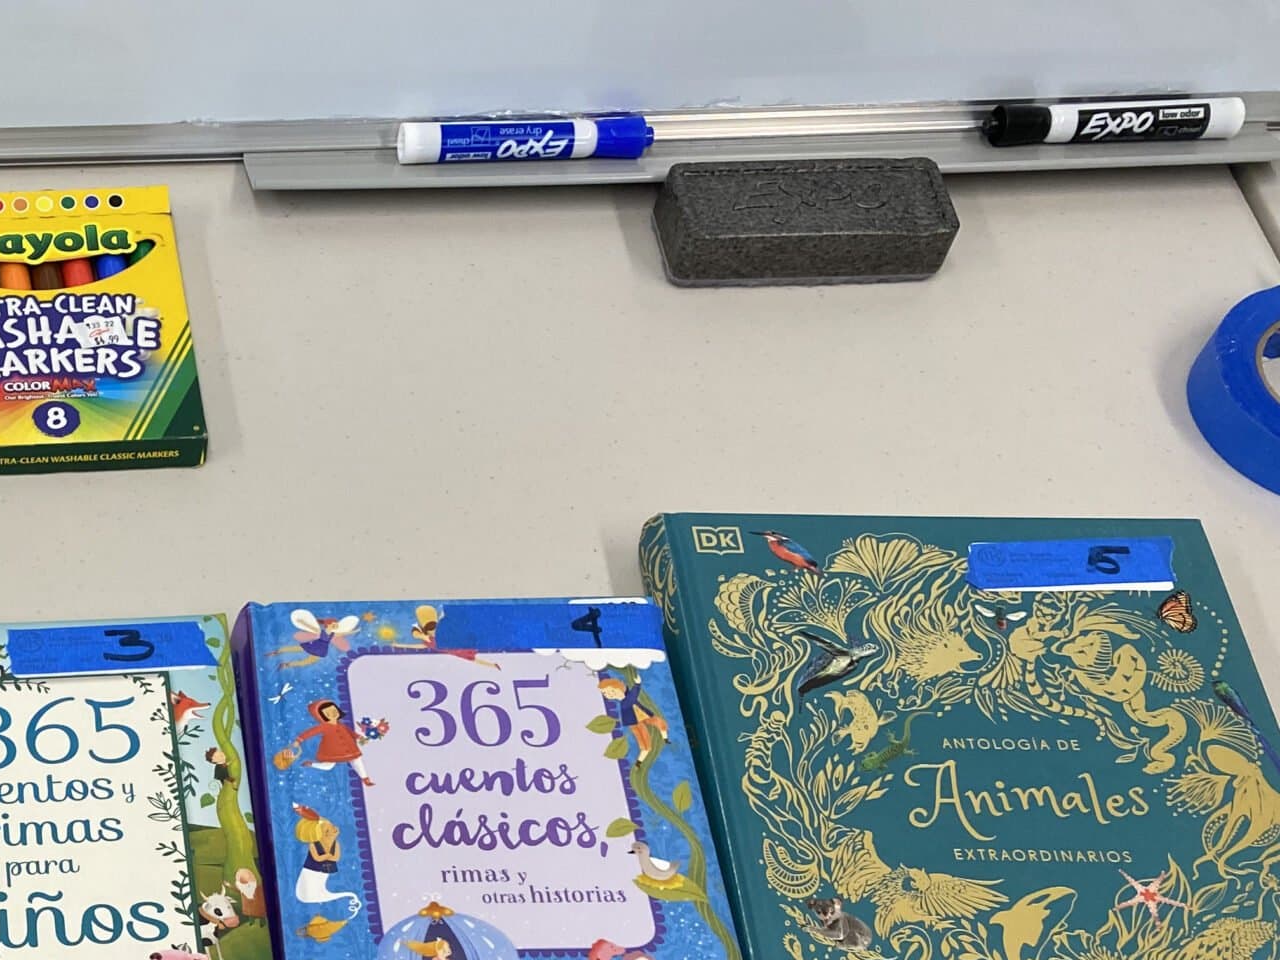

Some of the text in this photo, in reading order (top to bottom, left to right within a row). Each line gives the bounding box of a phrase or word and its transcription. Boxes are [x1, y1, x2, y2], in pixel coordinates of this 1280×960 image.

[1080, 111, 1155, 141] EXPO
[1162, 109, 1201, 119] low odor
[496, 129, 569, 159] EXPO
[499, 127, 543, 137] dry erase
[46, 406, 68, 430] 8
[50, 454, 99, 464] WASHABLE
[99, 451, 136, 462] CLASSIC
[136, 449, 180, 460] MARKERS
[699, 532, 738, 548] DK
[1087, 545, 1131, 576] 5
[571, 605, 603, 648] 4
[102, 628, 156, 662] 3
[406, 673, 563, 749] 365
[941, 736, 1081, 752] ANTOLOGÍA DE
[404, 757, 579, 797] cuentos
[121, 781, 136, 805] y
[903, 759, 1150, 842] Animales
[391, 802, 610, 859] clásicos,
[952, 848, 1134, 864] EXTRAORDINARIOS
[4, 855, 81, 888] para
[440, 864, 528, 886] rimas y
[481, 884, 628, 905] otras historias
